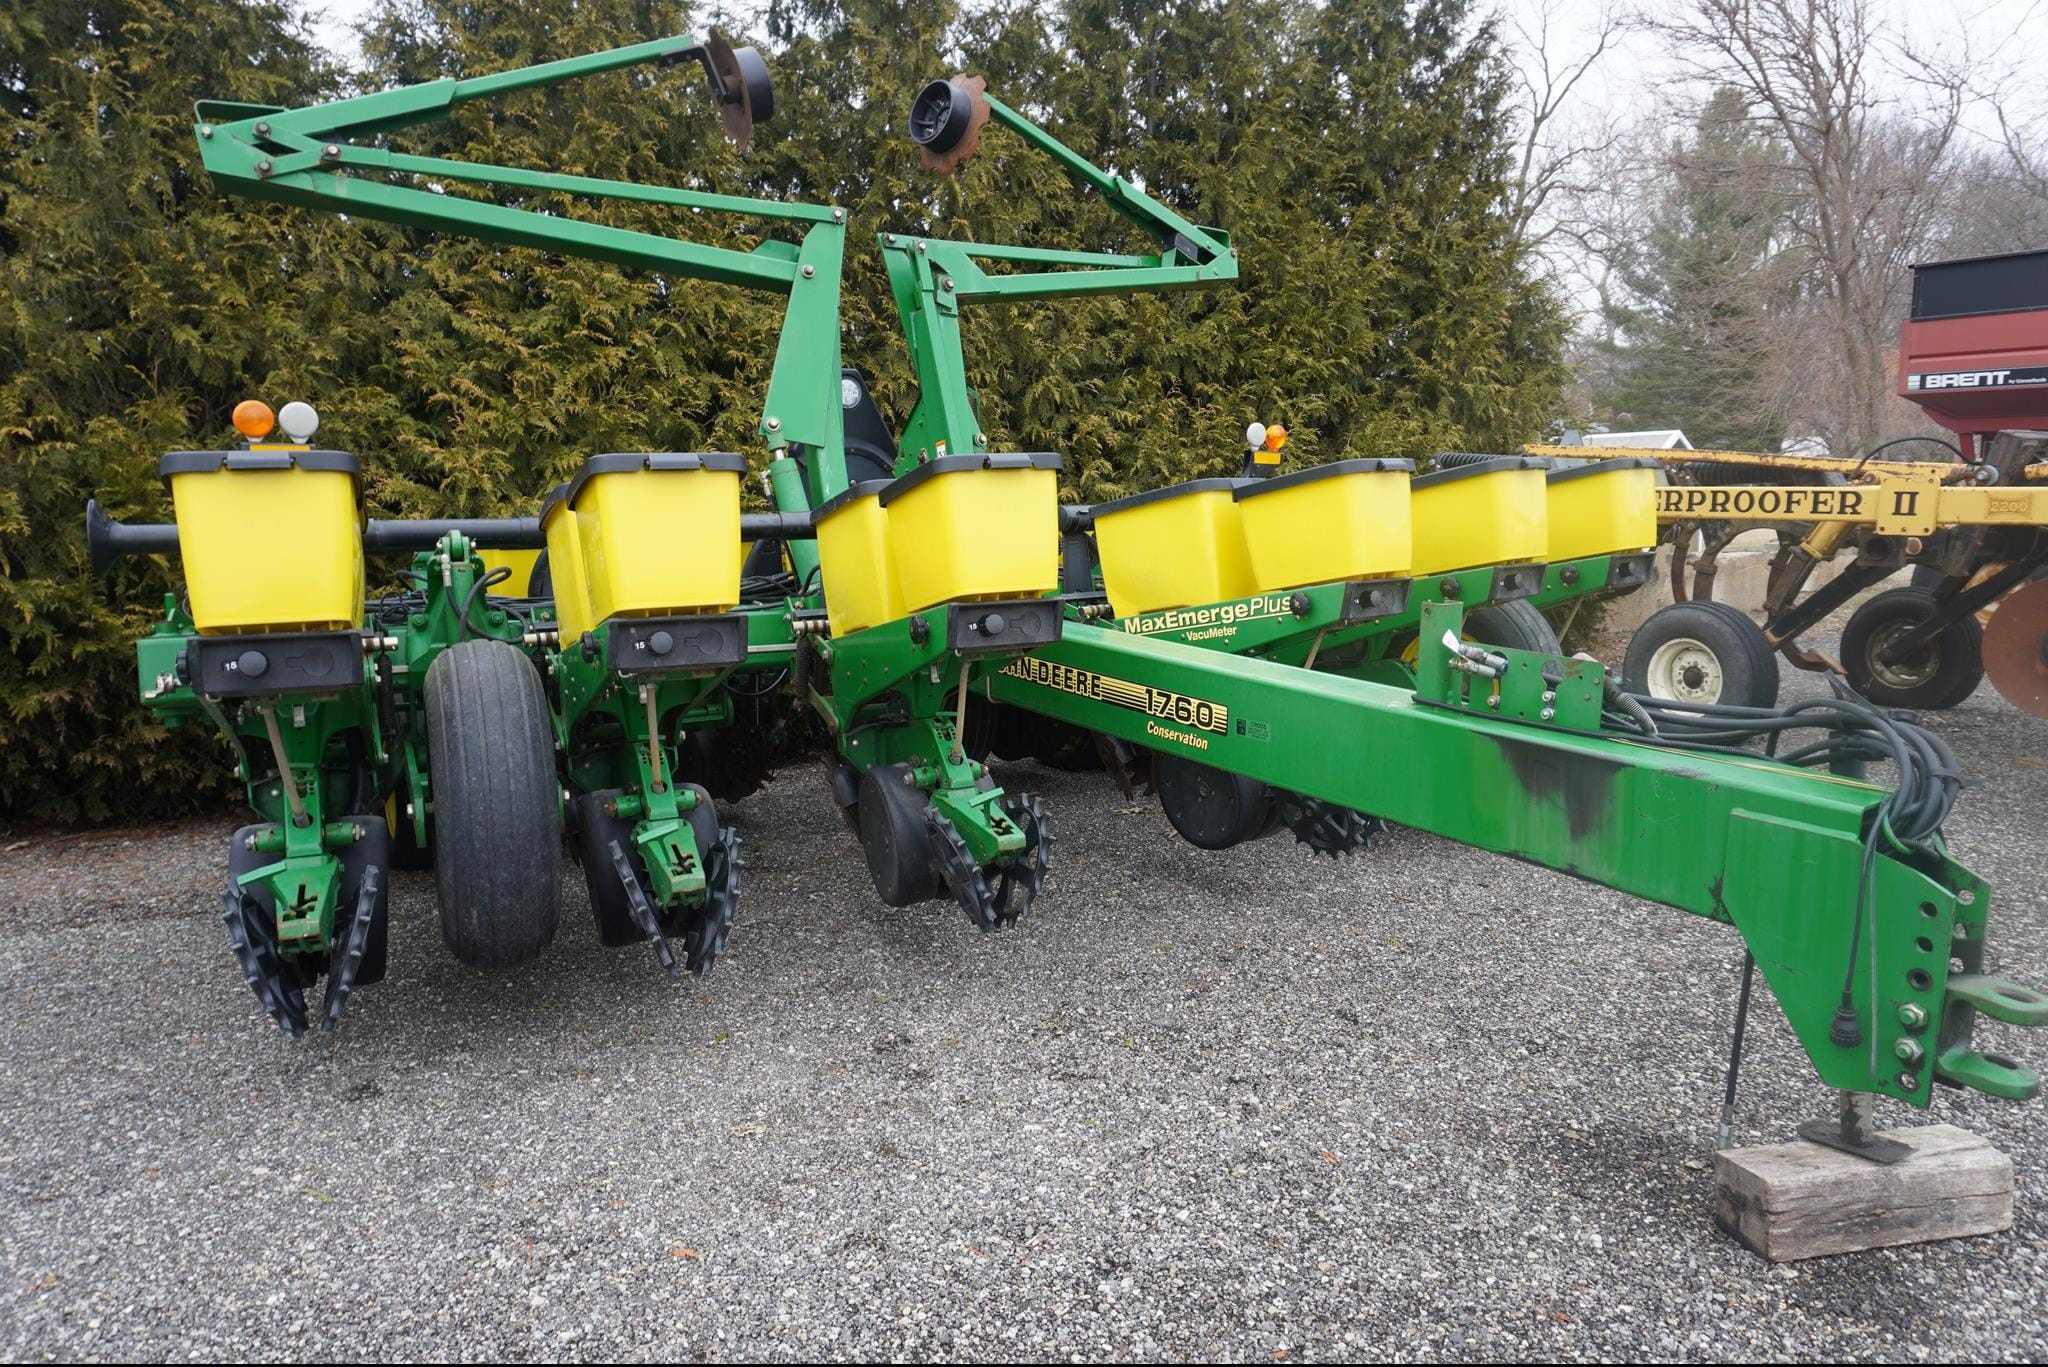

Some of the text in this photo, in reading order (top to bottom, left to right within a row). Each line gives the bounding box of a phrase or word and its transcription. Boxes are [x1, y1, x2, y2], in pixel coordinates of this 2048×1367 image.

[1925, 371, 2011, 388] BRENT
[1656, 490, 1920, 516] RPROOFER II
[1990, 501, 2028, 512] 2200
[1124, 596, 1292, 634] MaxEmergePlus
[1186, 626, 1237, 641] VacuMeter
[634, 641, 646, 650] 15
[225, 661, 237, 671] 15
[1037, 660, 1102, 701] DEERE
[1145, 687, 1214, 730] 1760
[1147, 720, 1209, 750] Conservation
